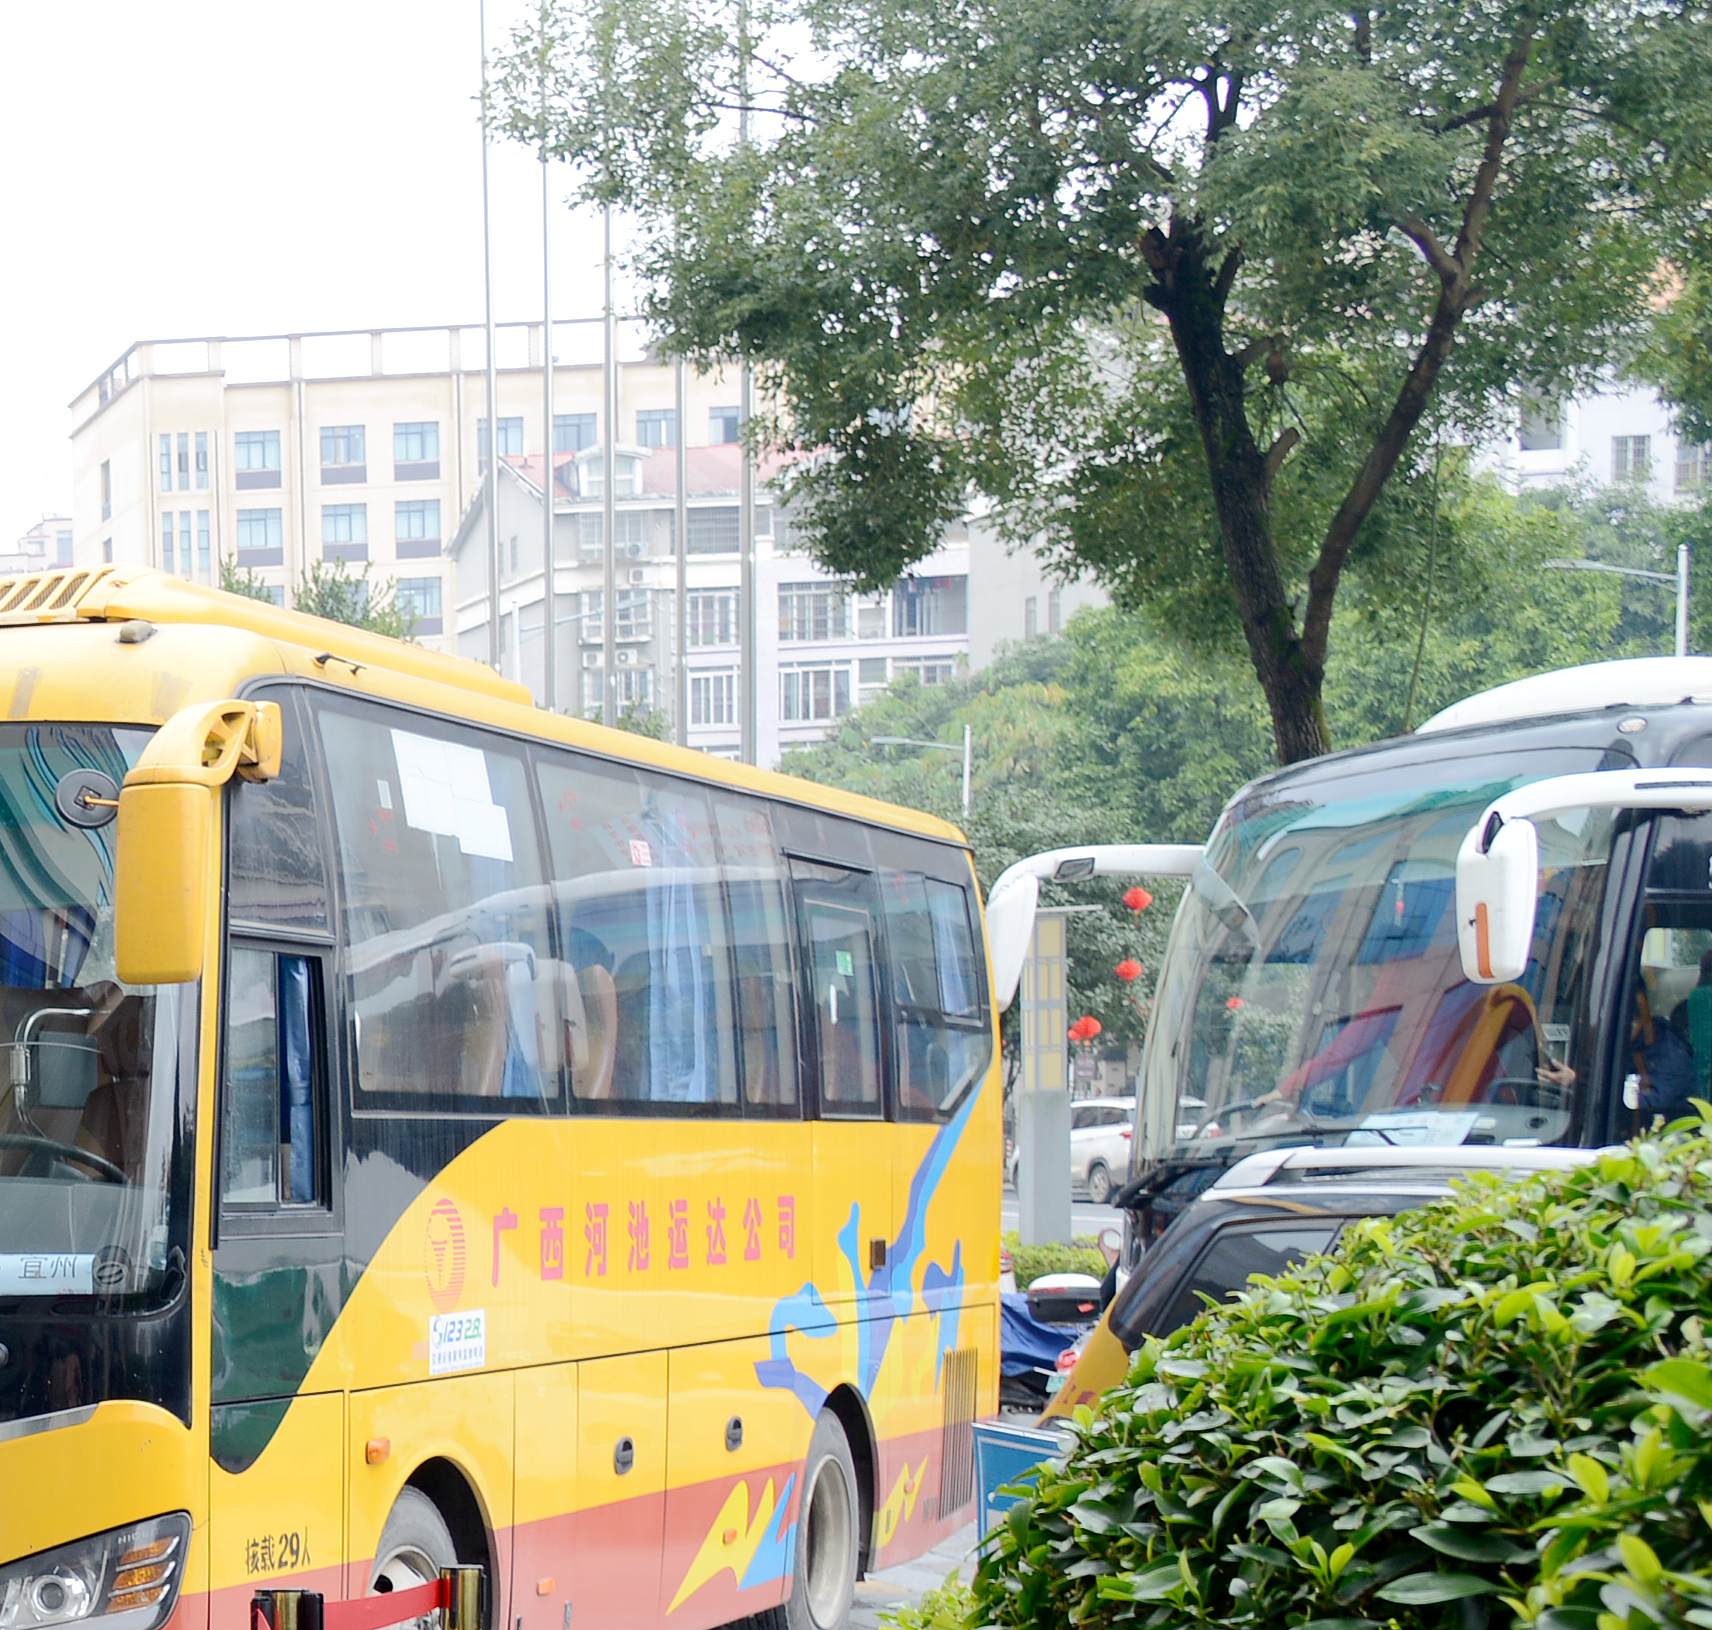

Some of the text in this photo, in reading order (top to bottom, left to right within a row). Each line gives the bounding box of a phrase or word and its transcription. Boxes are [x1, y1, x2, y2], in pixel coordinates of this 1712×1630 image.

[491, 1195, 795, 1288] 广西河池运达公司
